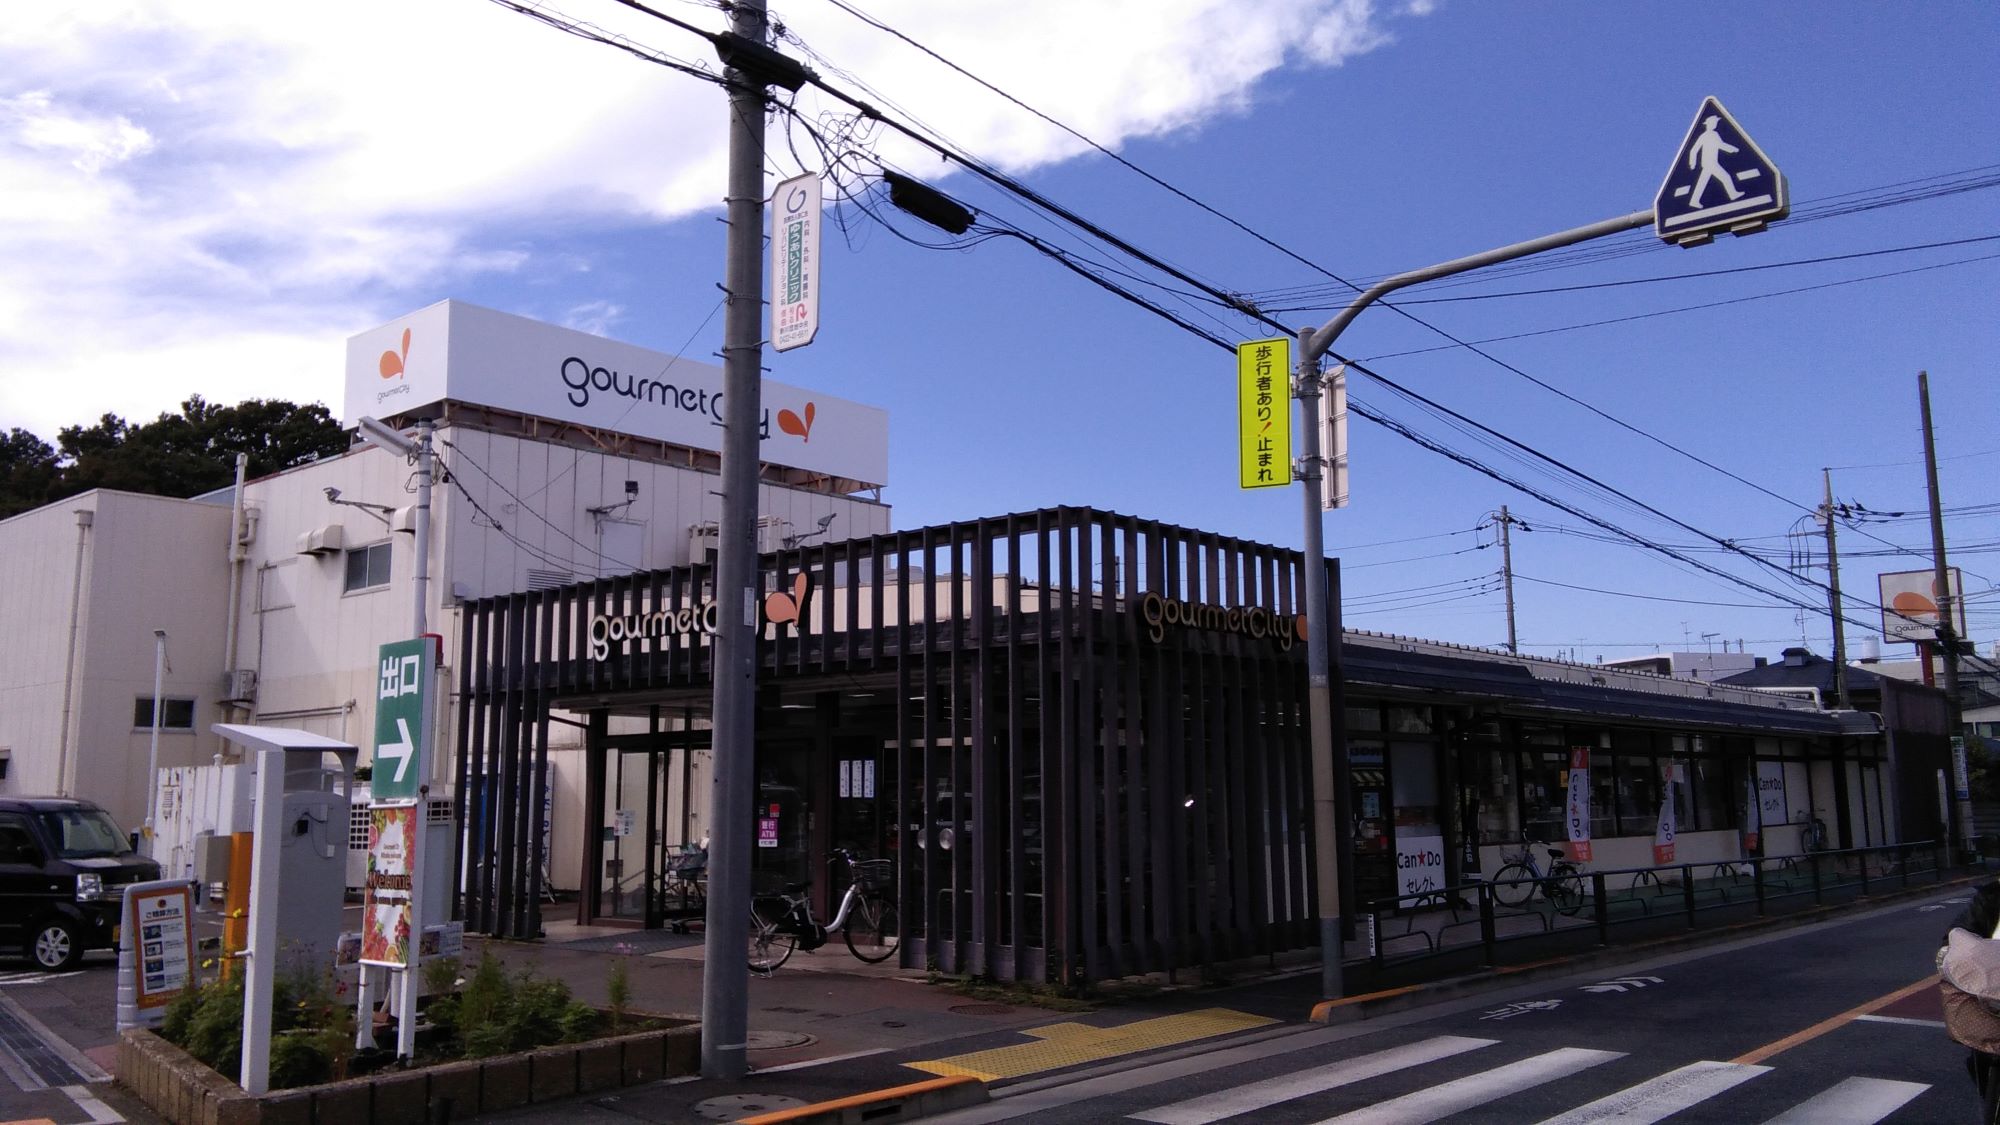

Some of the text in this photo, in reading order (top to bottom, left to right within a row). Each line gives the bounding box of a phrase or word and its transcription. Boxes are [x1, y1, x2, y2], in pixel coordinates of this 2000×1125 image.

[789, 223, 801, 303] ゆうあいクリニック
[1255, 345, 1273, 482] 歩行者あり！止まれ
[1143, 591, 1293, 651] gourmetCity
[380, 654, 419, 699] 出口
[761, 830, 776, 838] ATM
[368, 869, 411, 890] Welcome
[1406, 875, 1435, 894] セレクト
